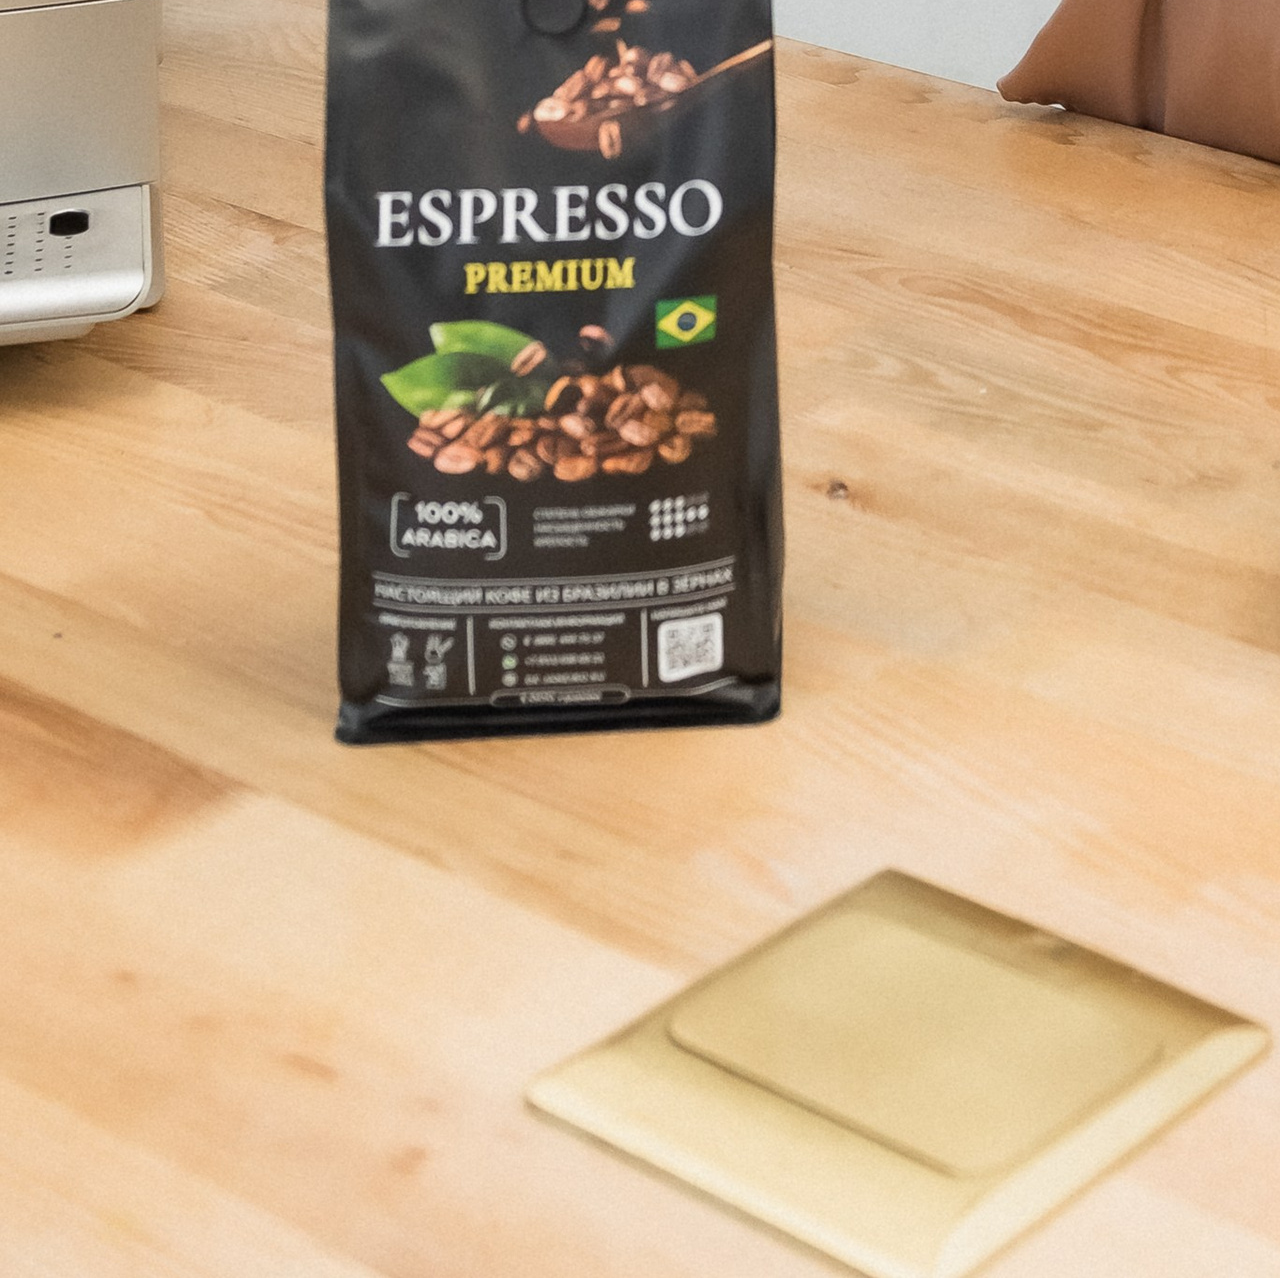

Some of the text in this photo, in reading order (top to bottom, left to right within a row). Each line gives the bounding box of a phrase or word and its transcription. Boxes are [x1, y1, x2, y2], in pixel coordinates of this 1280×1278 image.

[374, 178, 724, 247] ESPRESSO
[464, 257, 636, 294] PREMIUM
[414, 501, 484, 524] 100%
[401, 529, 499, 549] ARABICA
